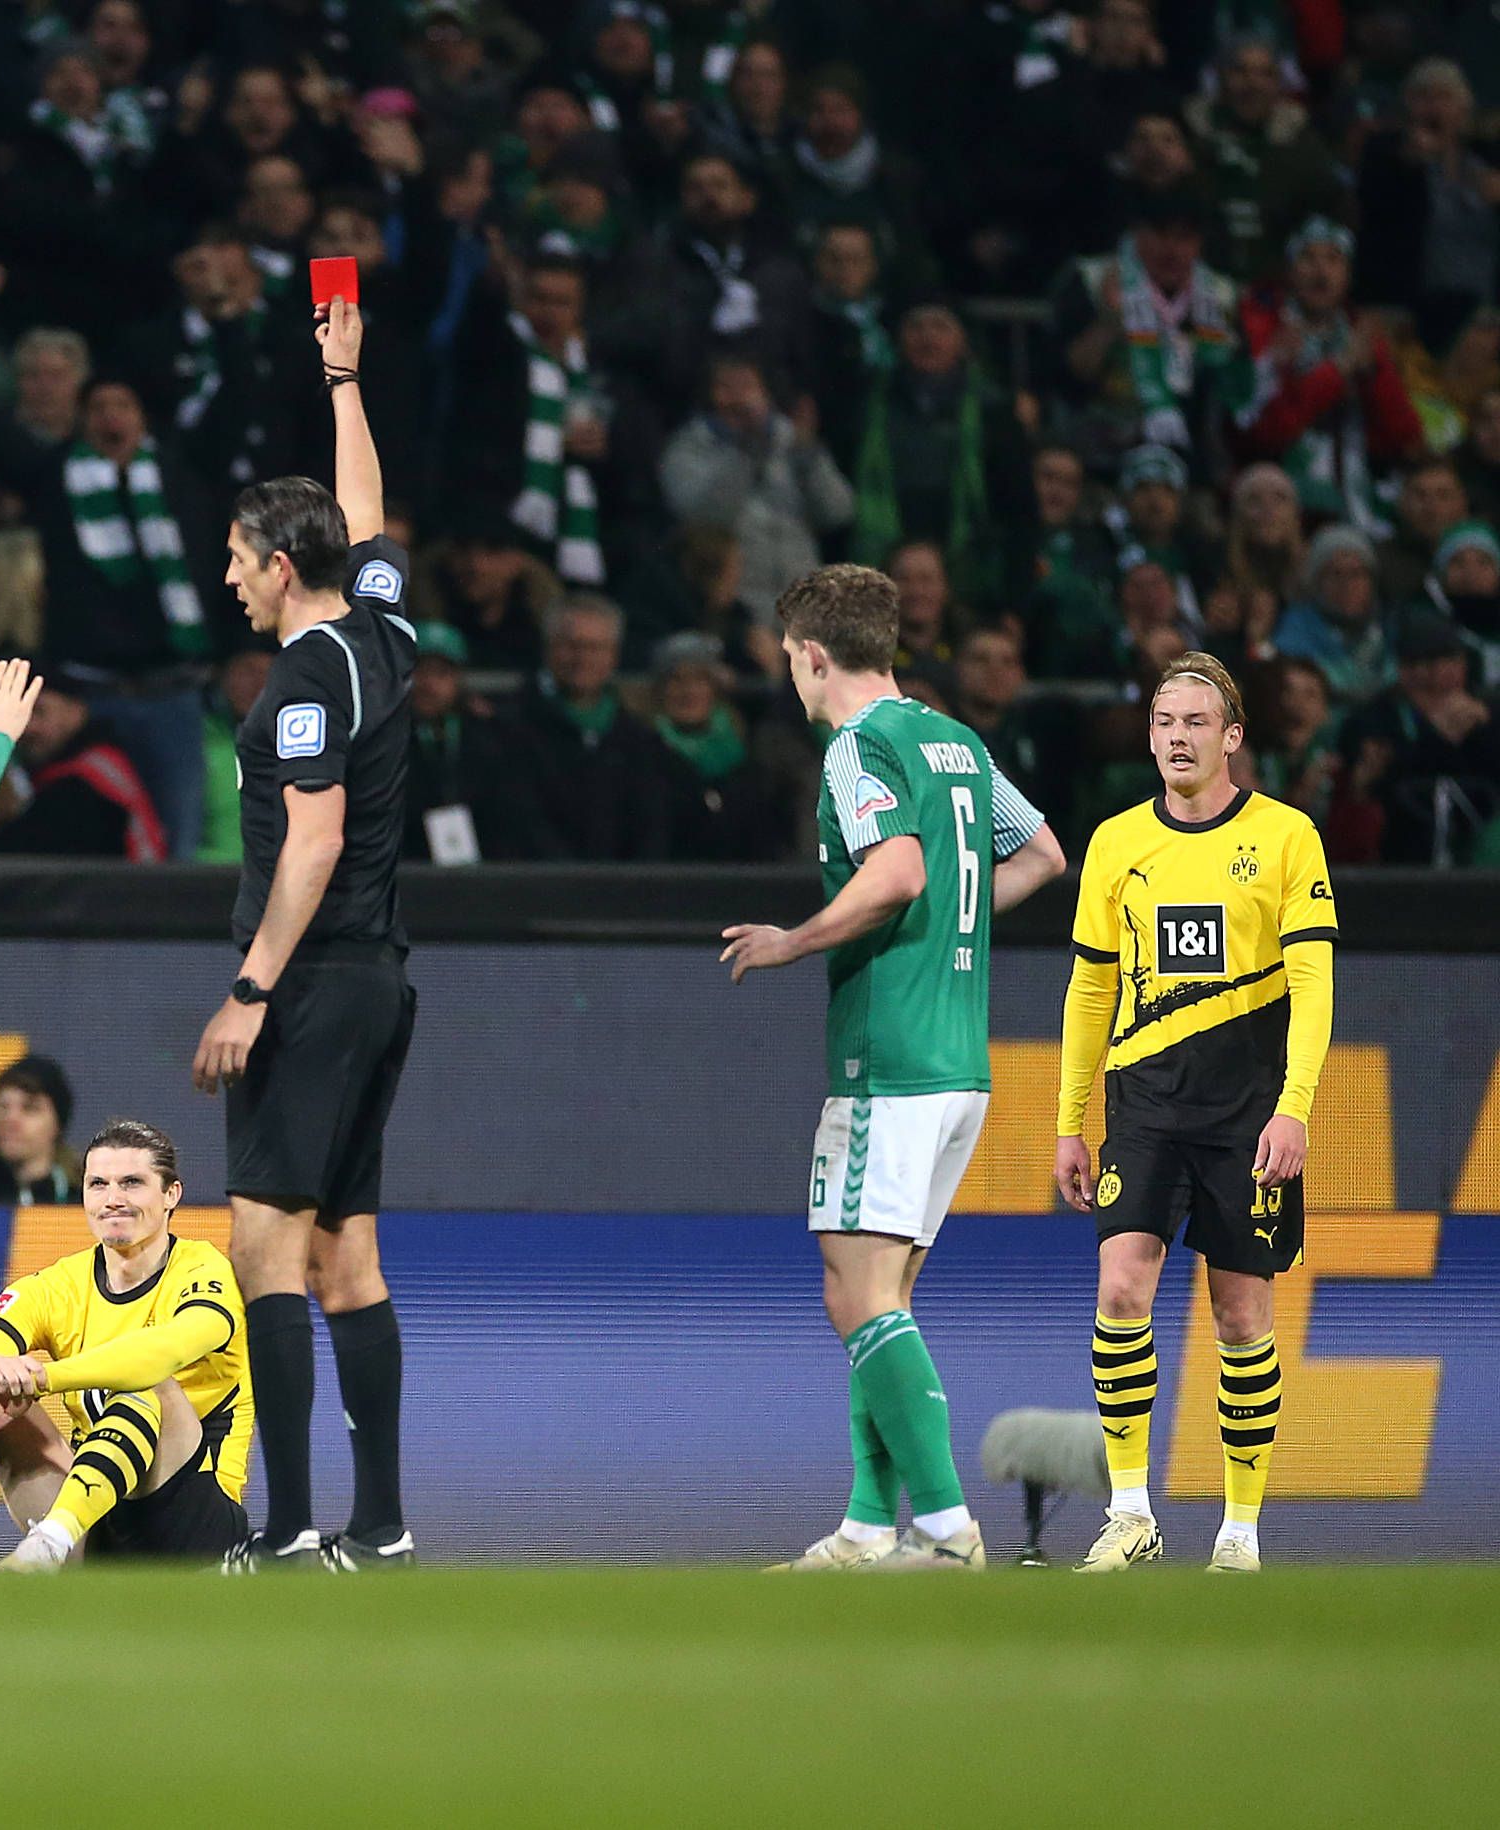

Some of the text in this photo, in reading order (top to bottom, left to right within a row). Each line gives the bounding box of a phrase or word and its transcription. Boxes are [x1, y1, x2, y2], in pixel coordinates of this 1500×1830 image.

[949, 786, 980, 934] 6
[1232, 857, 1258, 876] BVB
[1162, 920, 1217, 957] 1&1
[811, 1155, 827, 1208] 6
[1100, 1177, 1118, 1199] BVB
